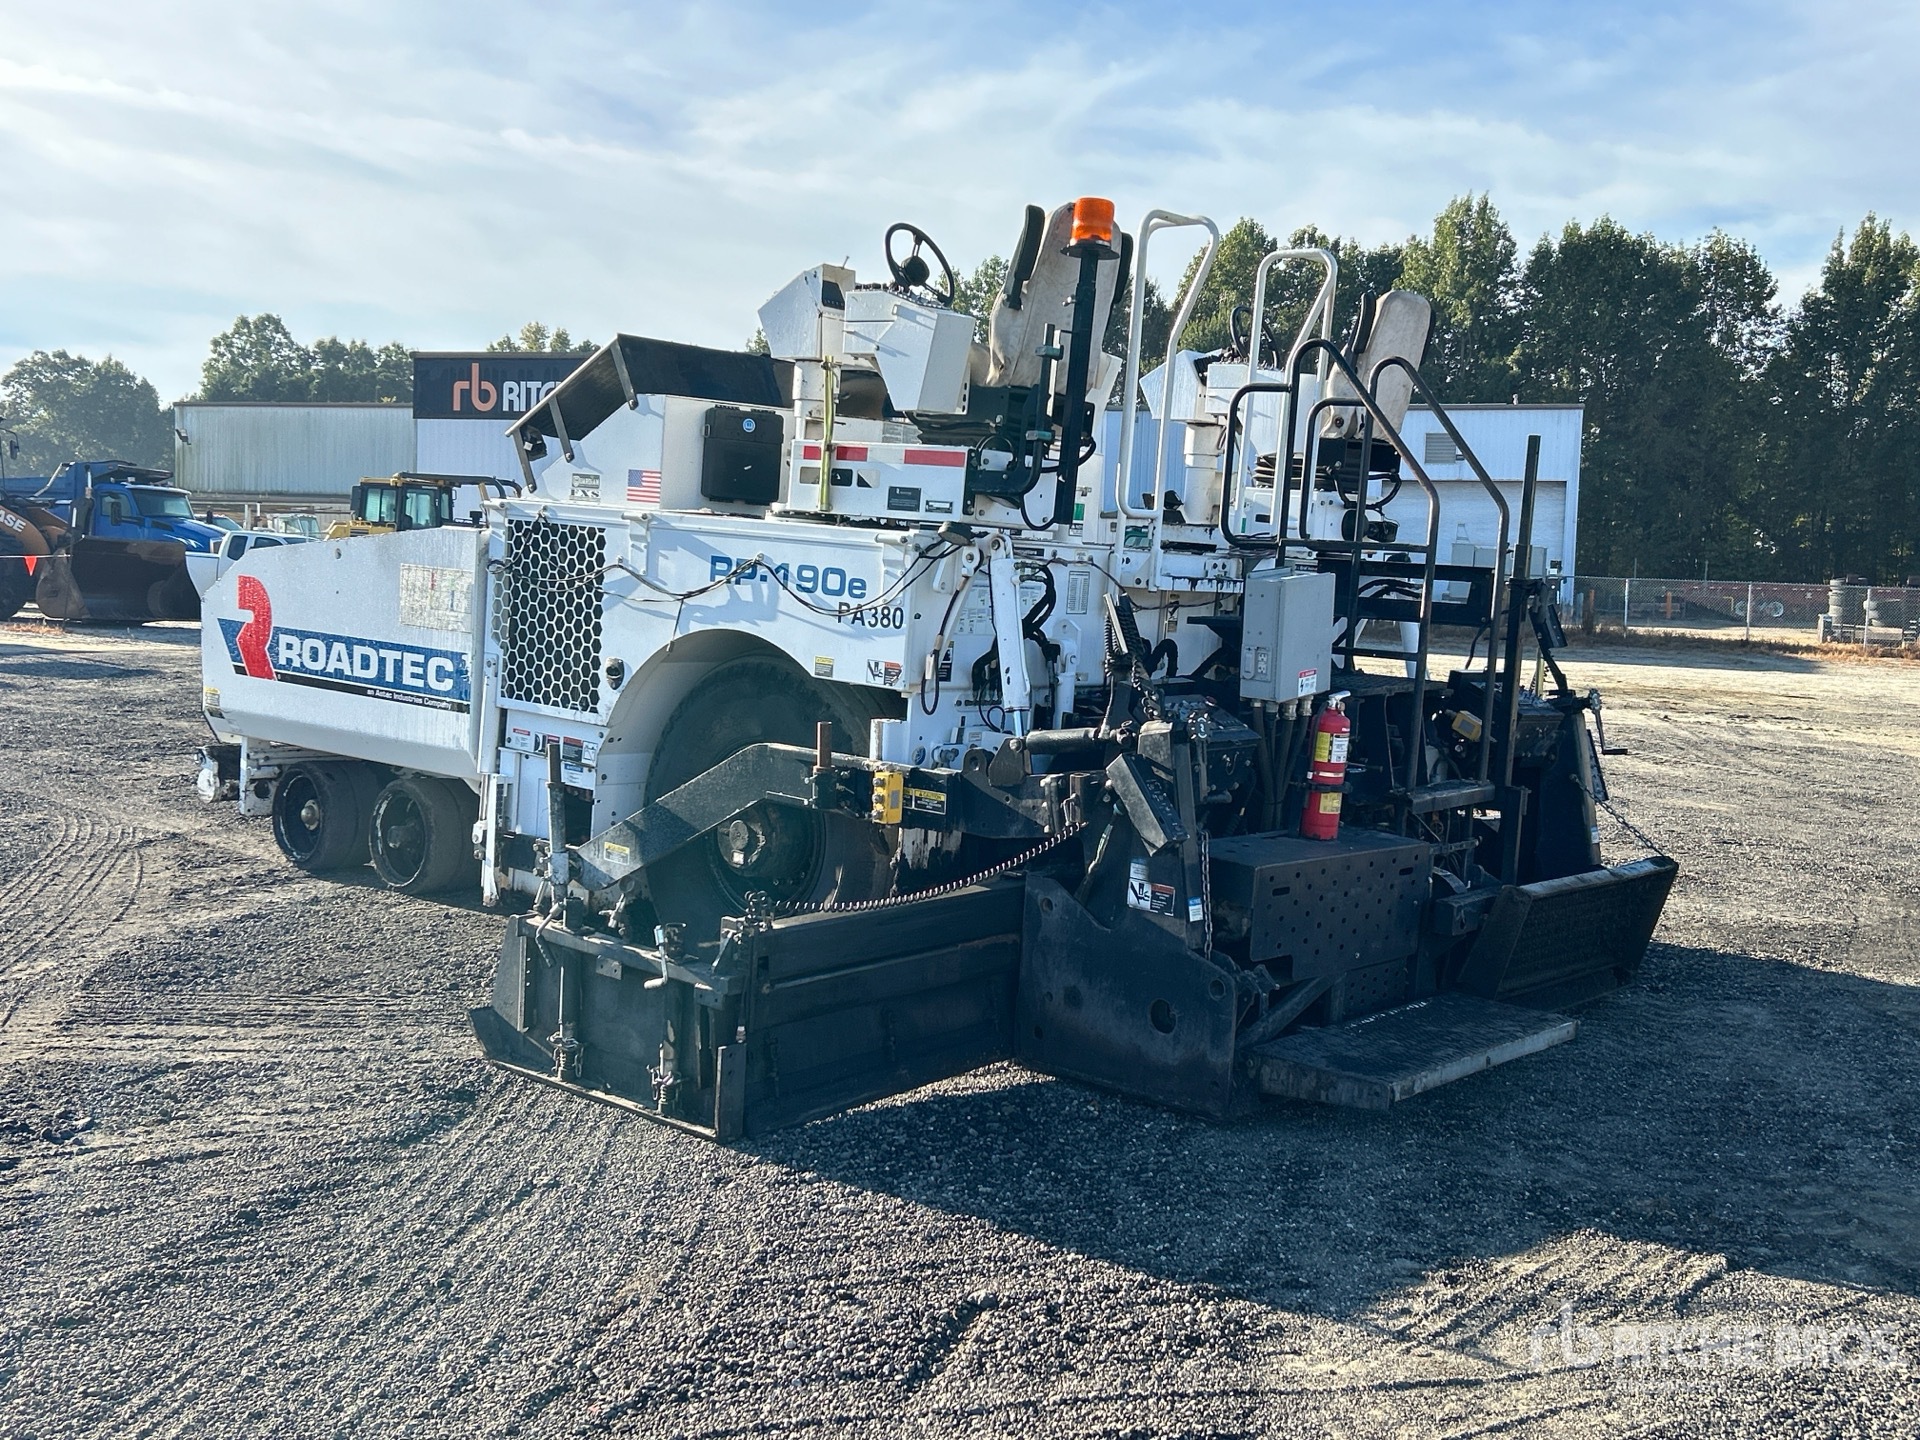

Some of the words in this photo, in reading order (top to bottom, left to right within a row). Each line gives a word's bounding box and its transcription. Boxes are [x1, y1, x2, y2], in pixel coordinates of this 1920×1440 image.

[452, 362, 498, 412] rb
[502, 380, 562, 412] RITC
[836, 601, 905, 630] PA380
[278, 633, 455, 692] ROADTEC
[393, 692, 423, 704] Industries
[423, 697, 452, 710] Company
